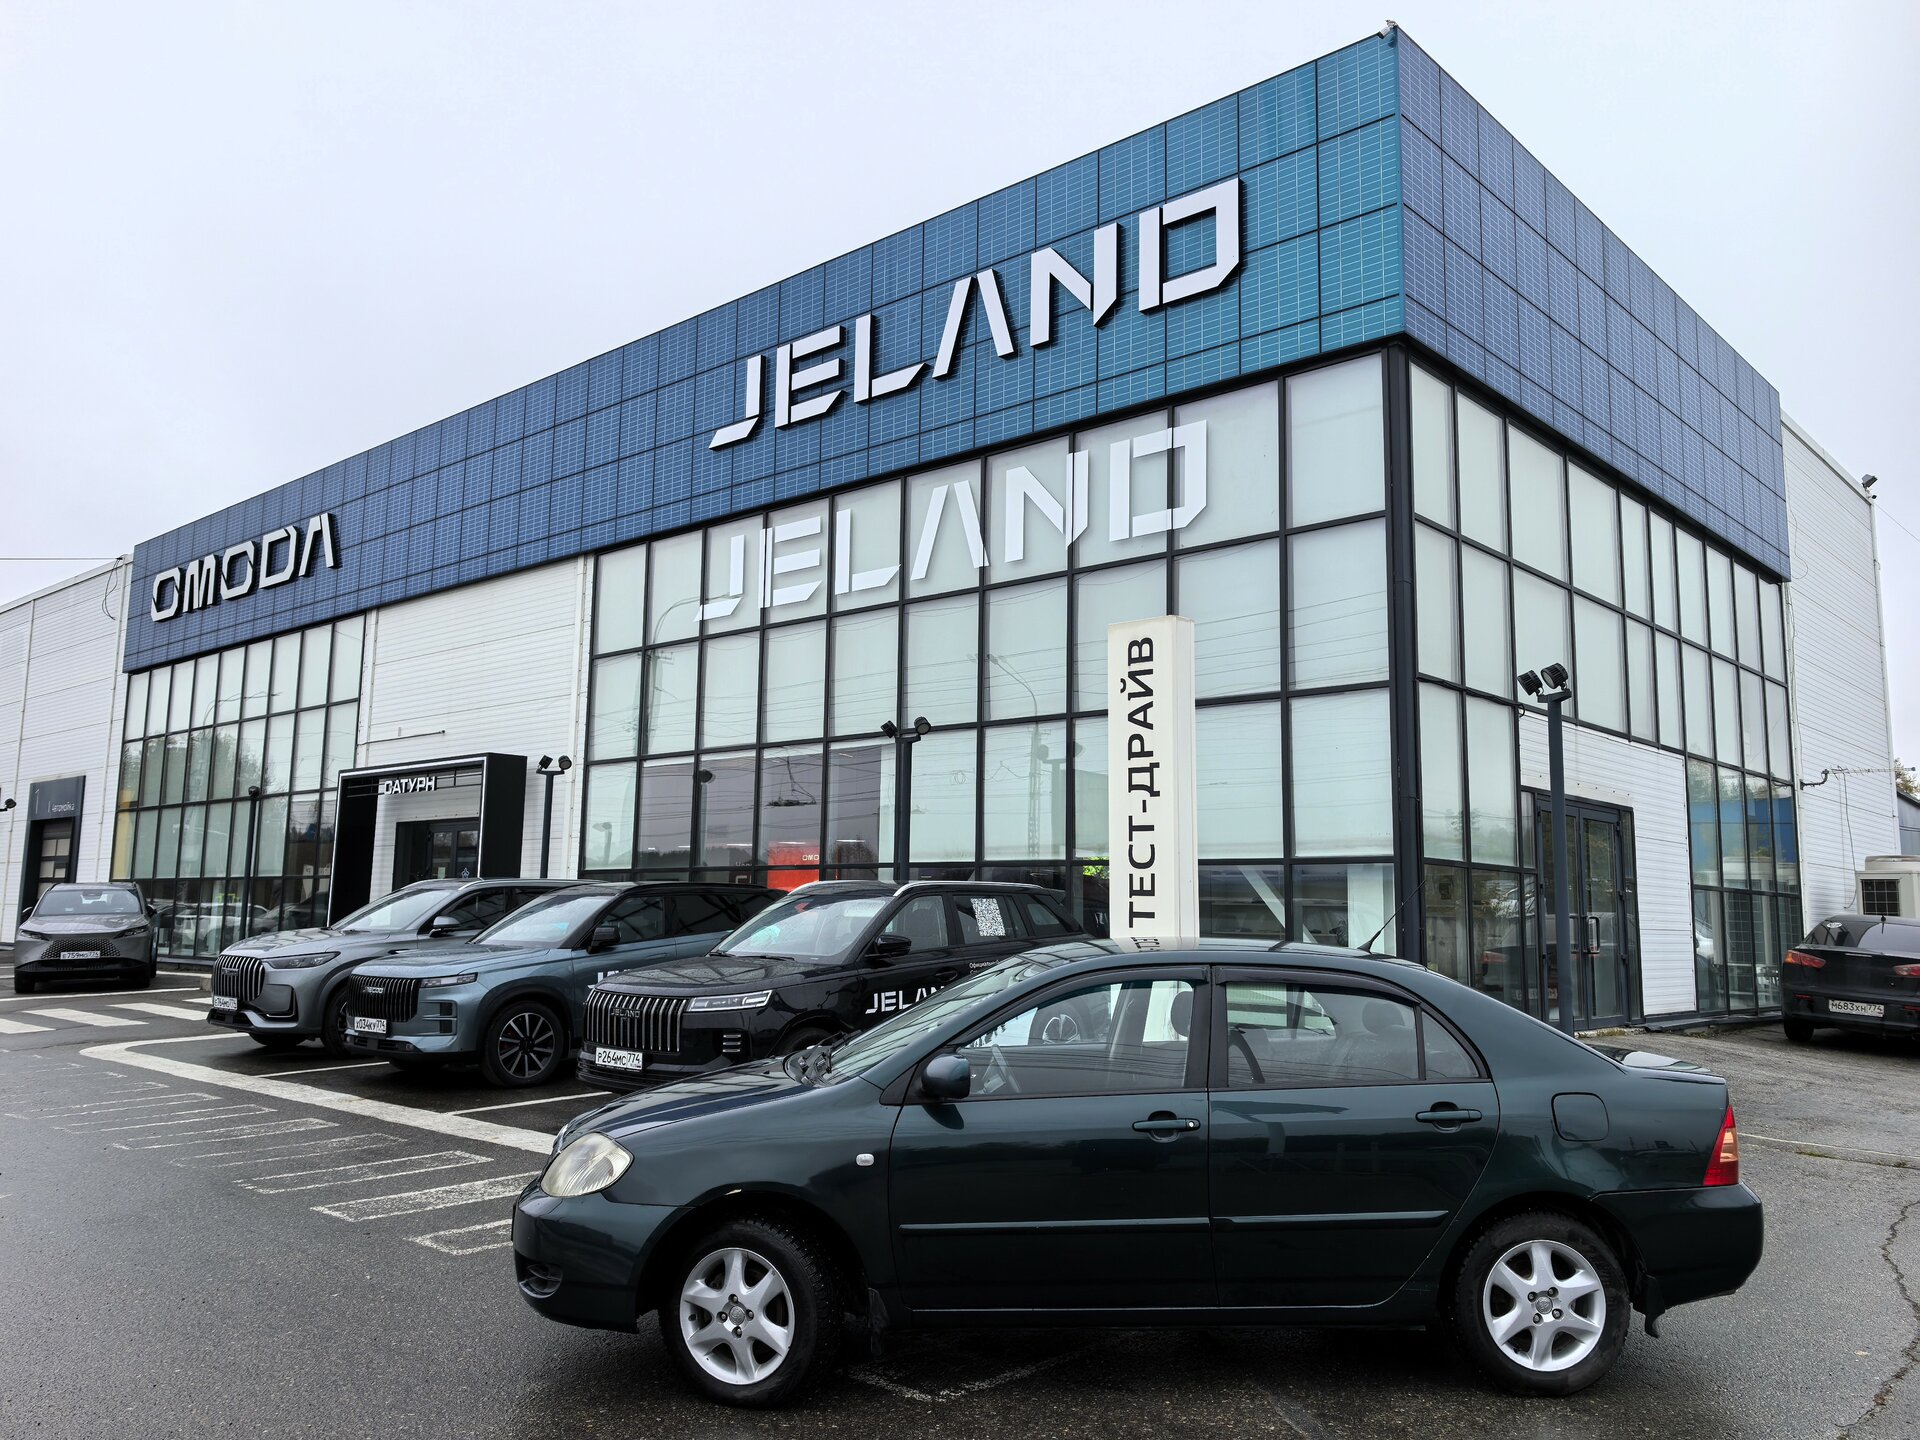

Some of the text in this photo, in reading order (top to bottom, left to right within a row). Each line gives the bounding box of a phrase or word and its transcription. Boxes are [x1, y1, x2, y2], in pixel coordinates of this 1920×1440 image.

[709, 178, 1239, 449] JELAND
[150, 513, 334, 622] OMODA
[693, 420, 1207, 621] JELAND
[384, 776, 435, 794] САТУРН
[1120, 636, 1160, 929] ТЕСТ-ДРАЙВ
